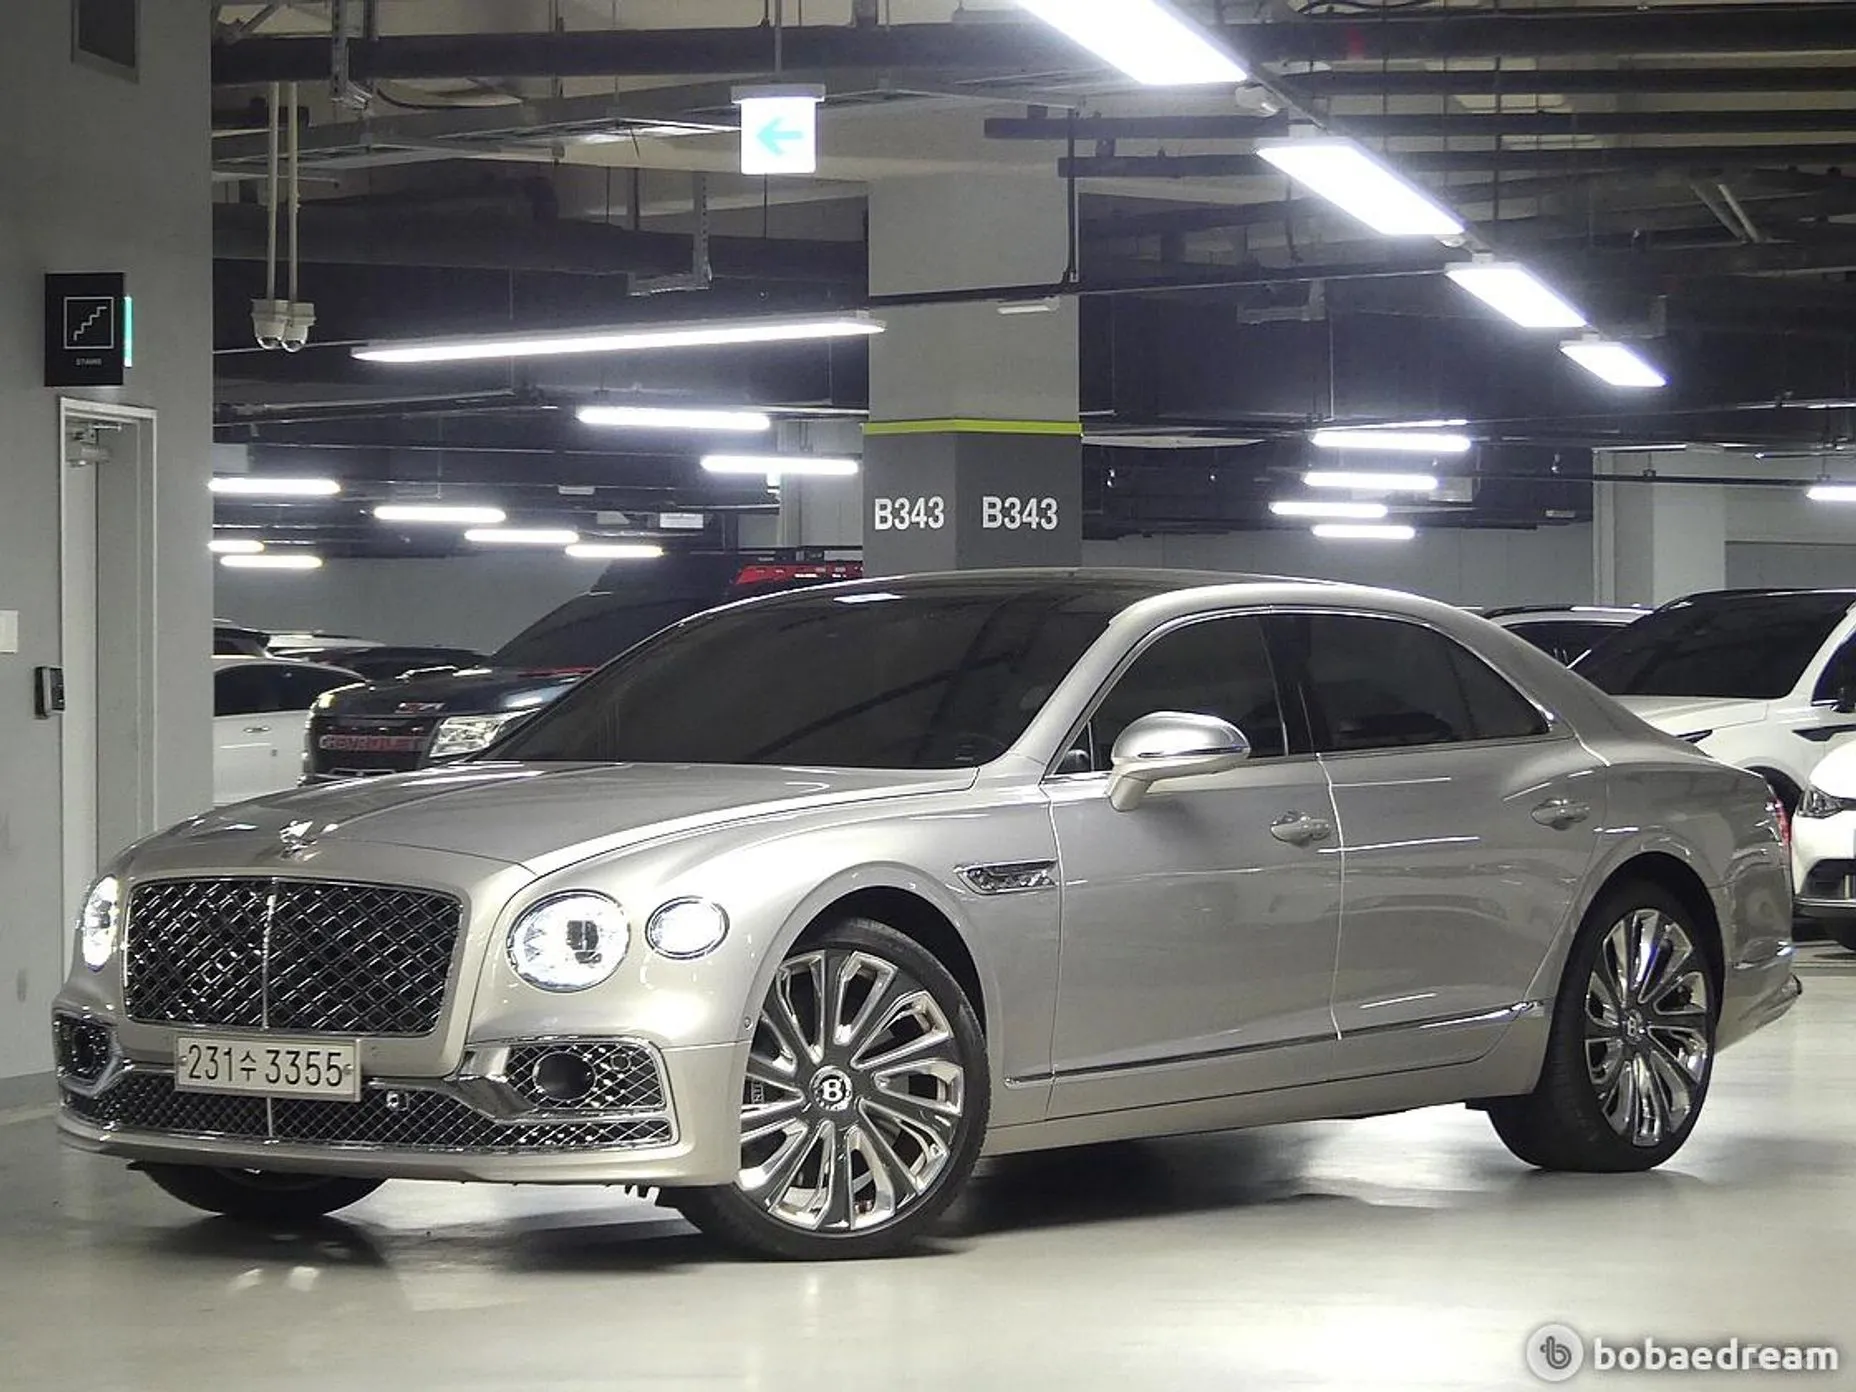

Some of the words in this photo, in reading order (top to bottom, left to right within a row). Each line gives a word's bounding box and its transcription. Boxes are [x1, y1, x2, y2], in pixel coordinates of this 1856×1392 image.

[873, 496, 945, 530] B343
[982, 496, 1058, 530] B343
[822, 1079, 843, 1101] B
